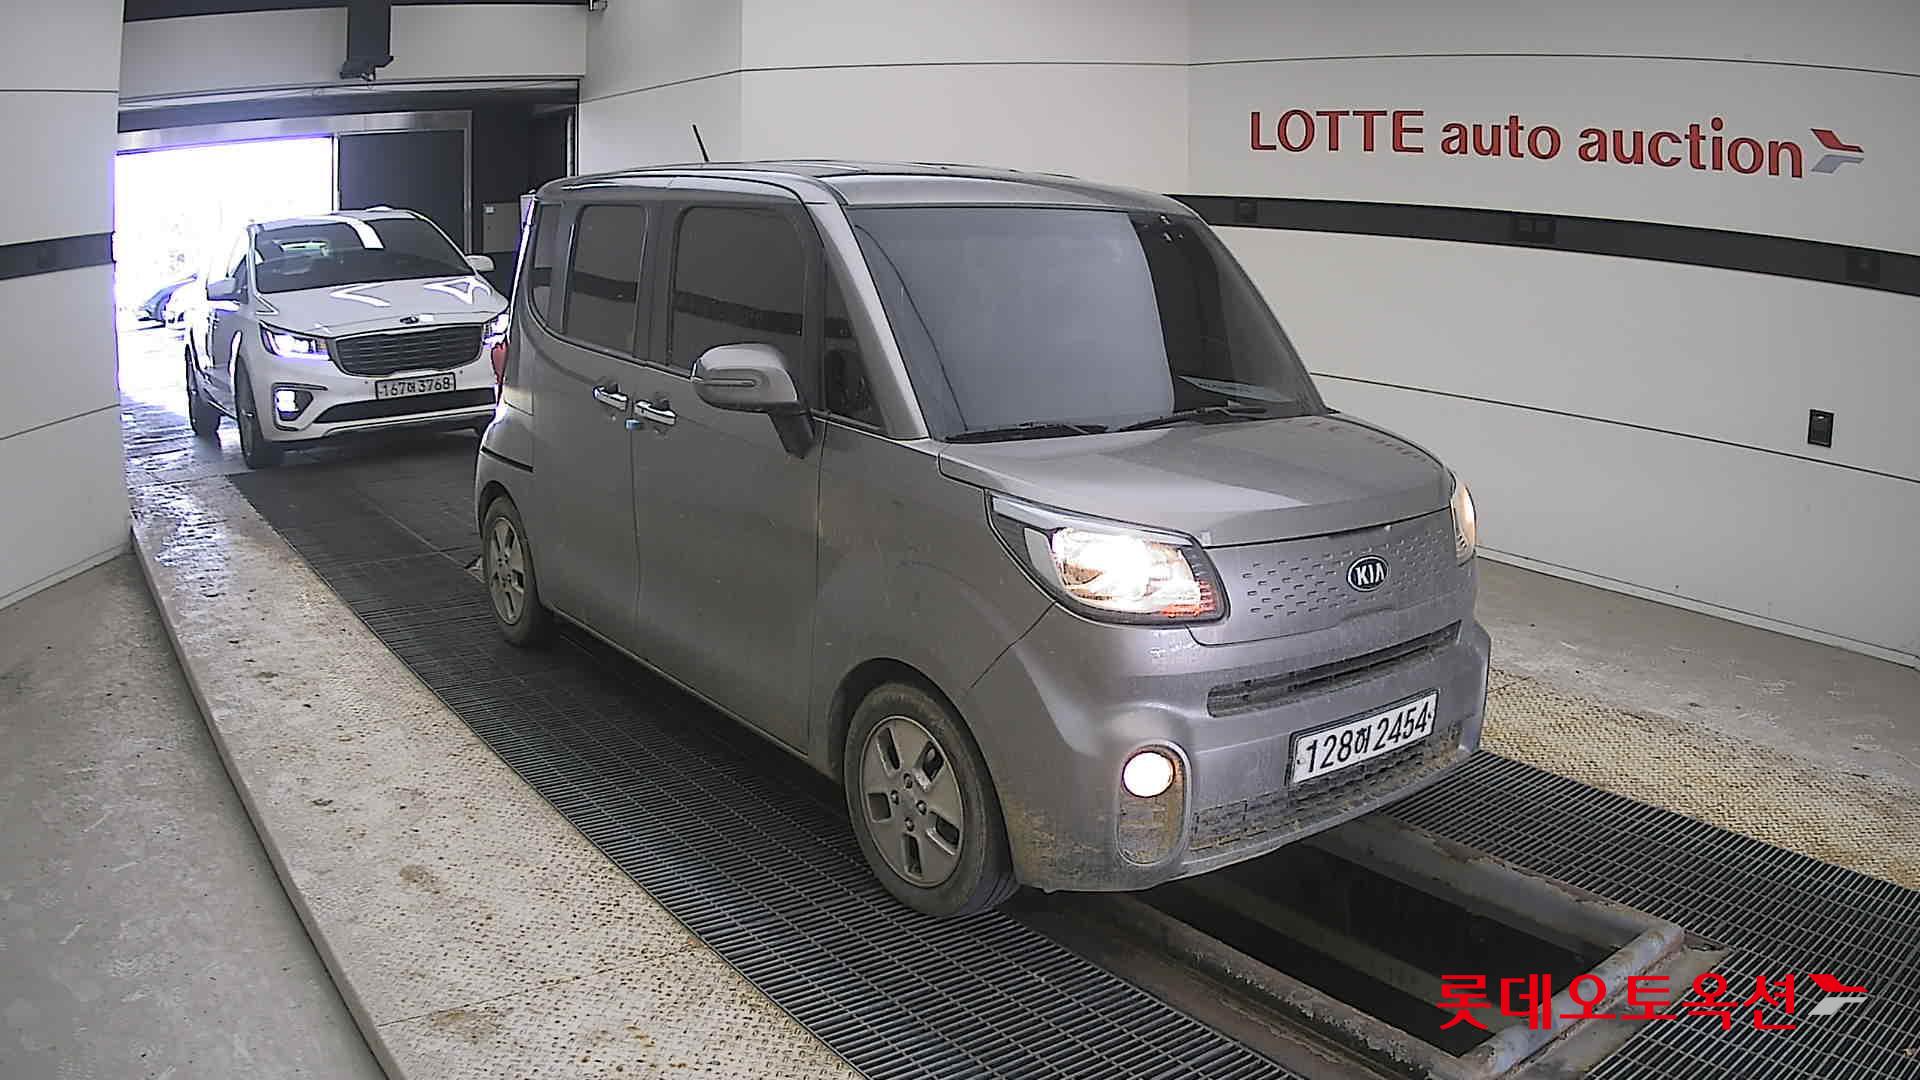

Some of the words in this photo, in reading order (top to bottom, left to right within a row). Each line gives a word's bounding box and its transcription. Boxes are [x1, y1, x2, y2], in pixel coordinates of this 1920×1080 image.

[1250, 109, 1424, 153] LOTTE
[1440, 115, 1562, 160] auto
[1577, 116, 1803, 178] auction
[1353, 561, 1385, 587] KIA
